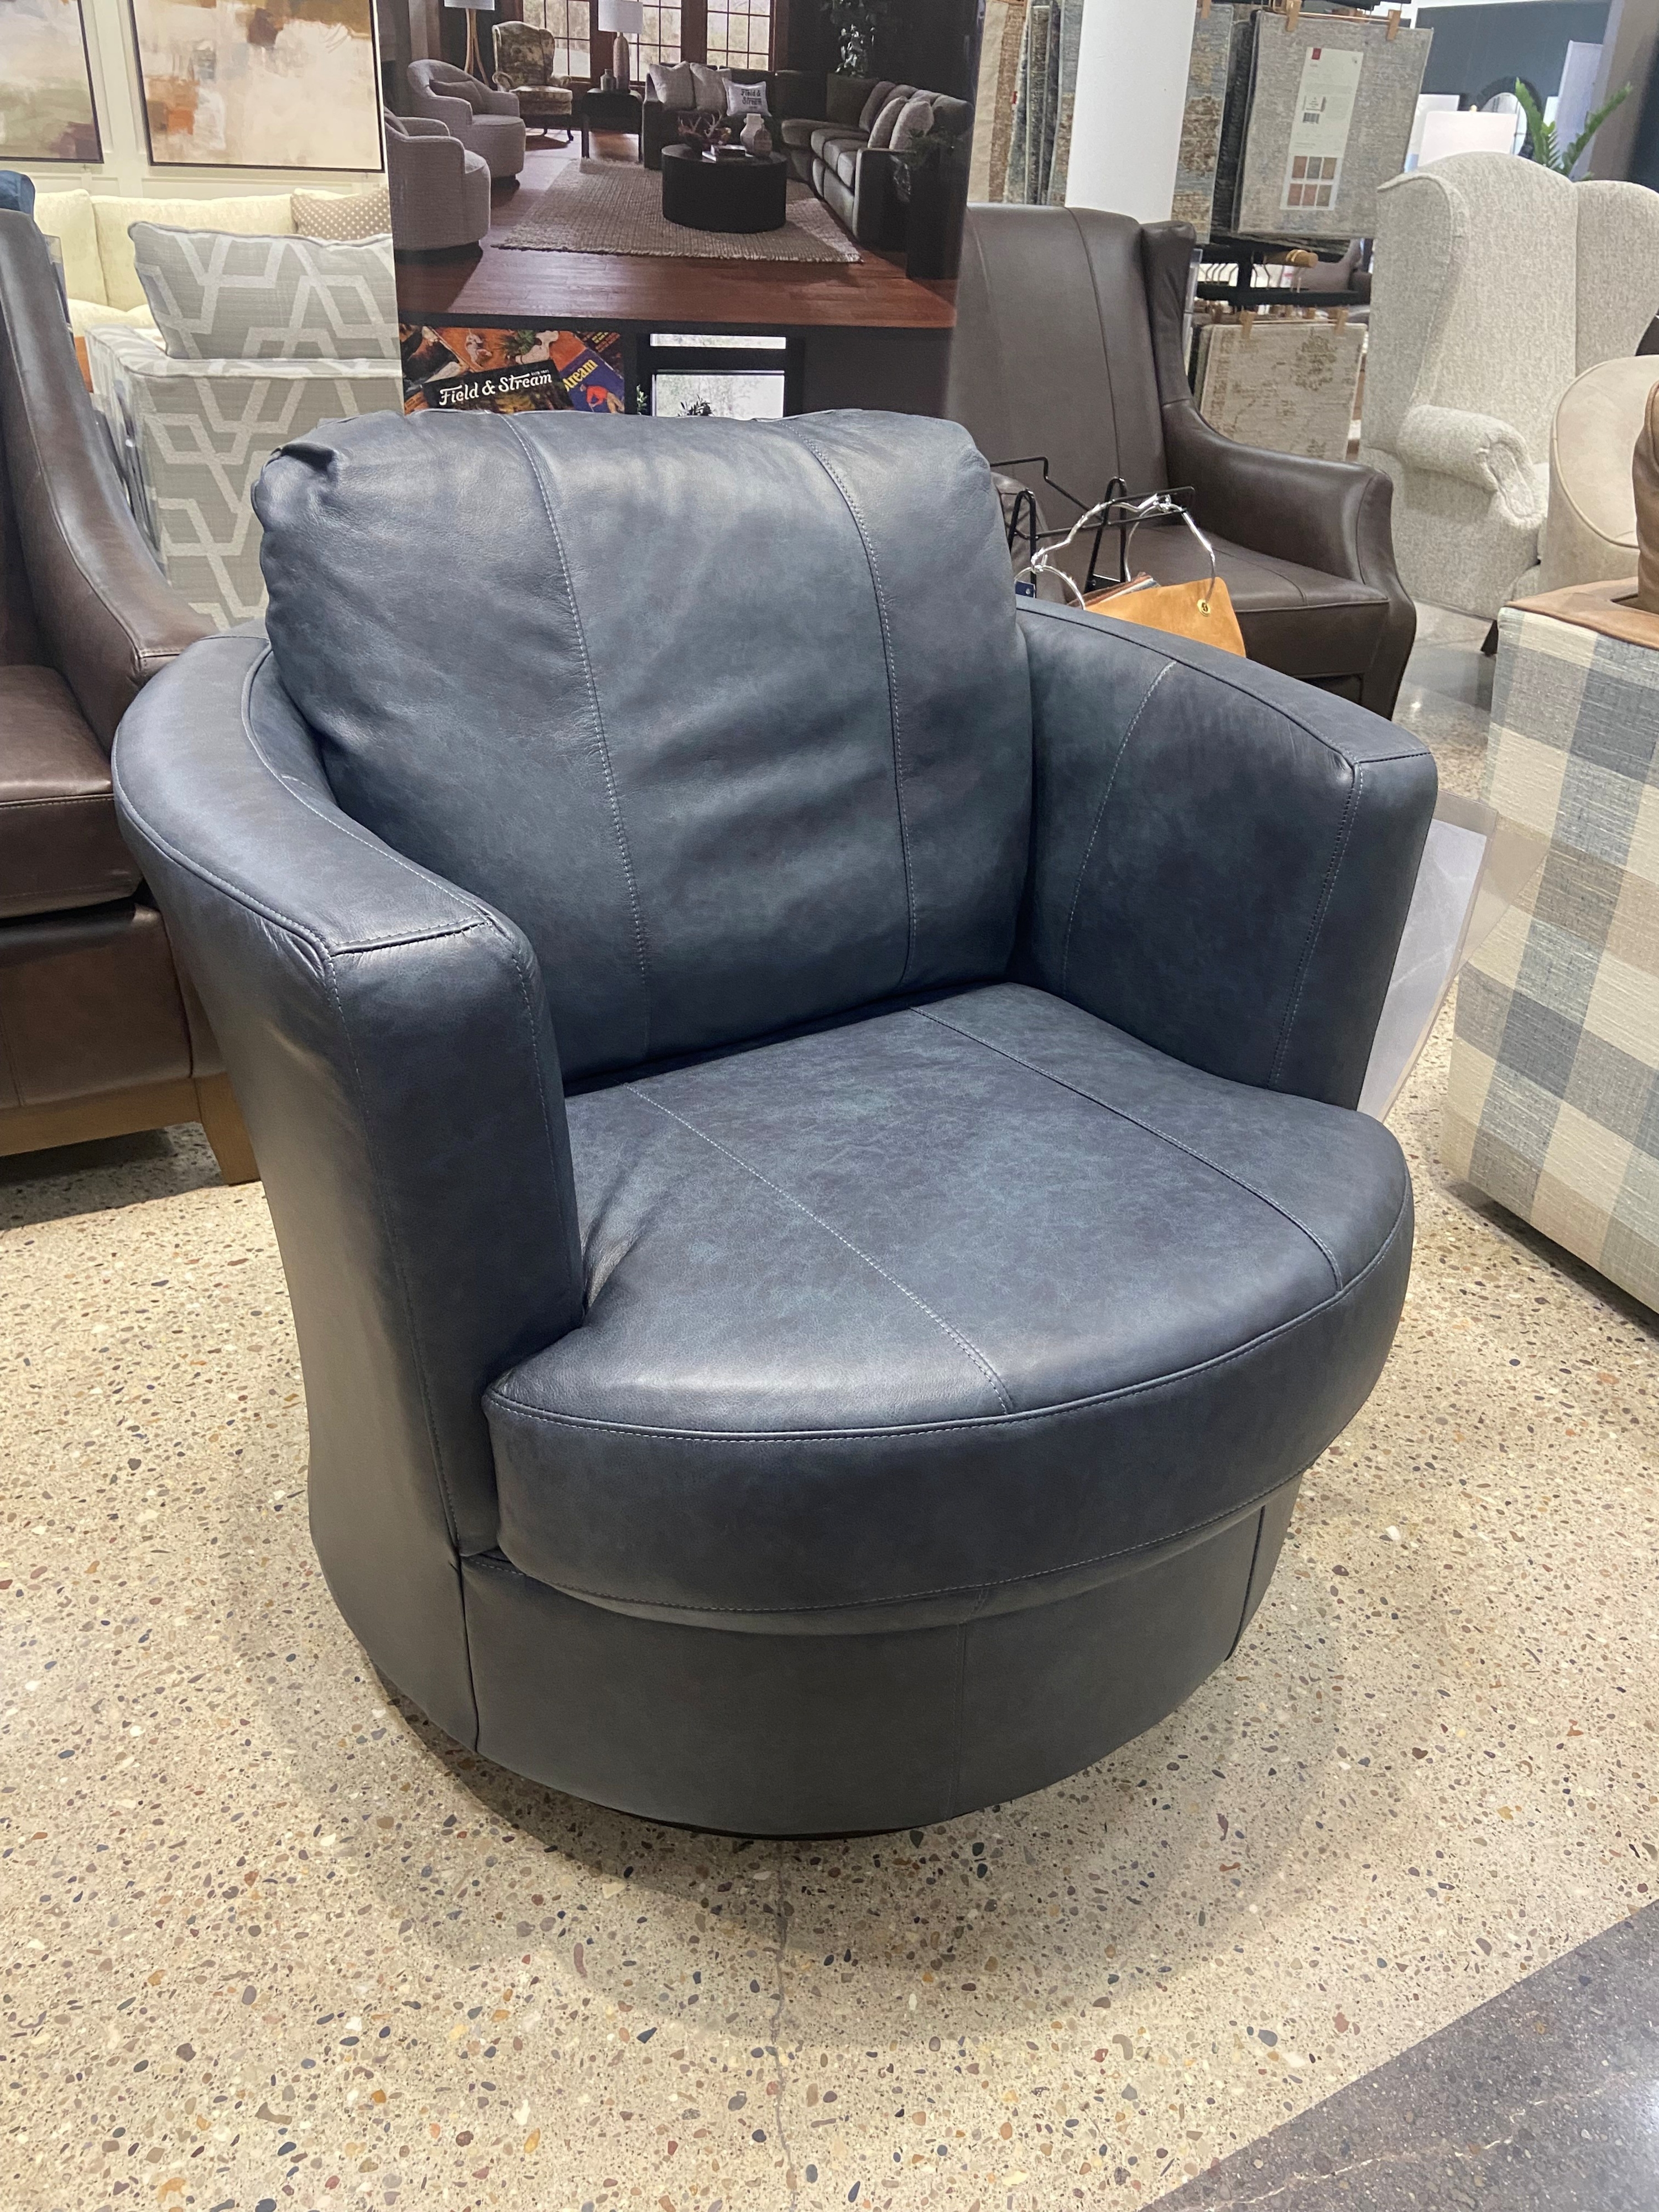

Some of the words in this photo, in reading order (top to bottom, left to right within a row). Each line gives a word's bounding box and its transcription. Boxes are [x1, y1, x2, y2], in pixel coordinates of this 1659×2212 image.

[439, 382, 479, 406] Field
[482, 379, 495, 396] &
[498, 373, 552, 393] Stream
